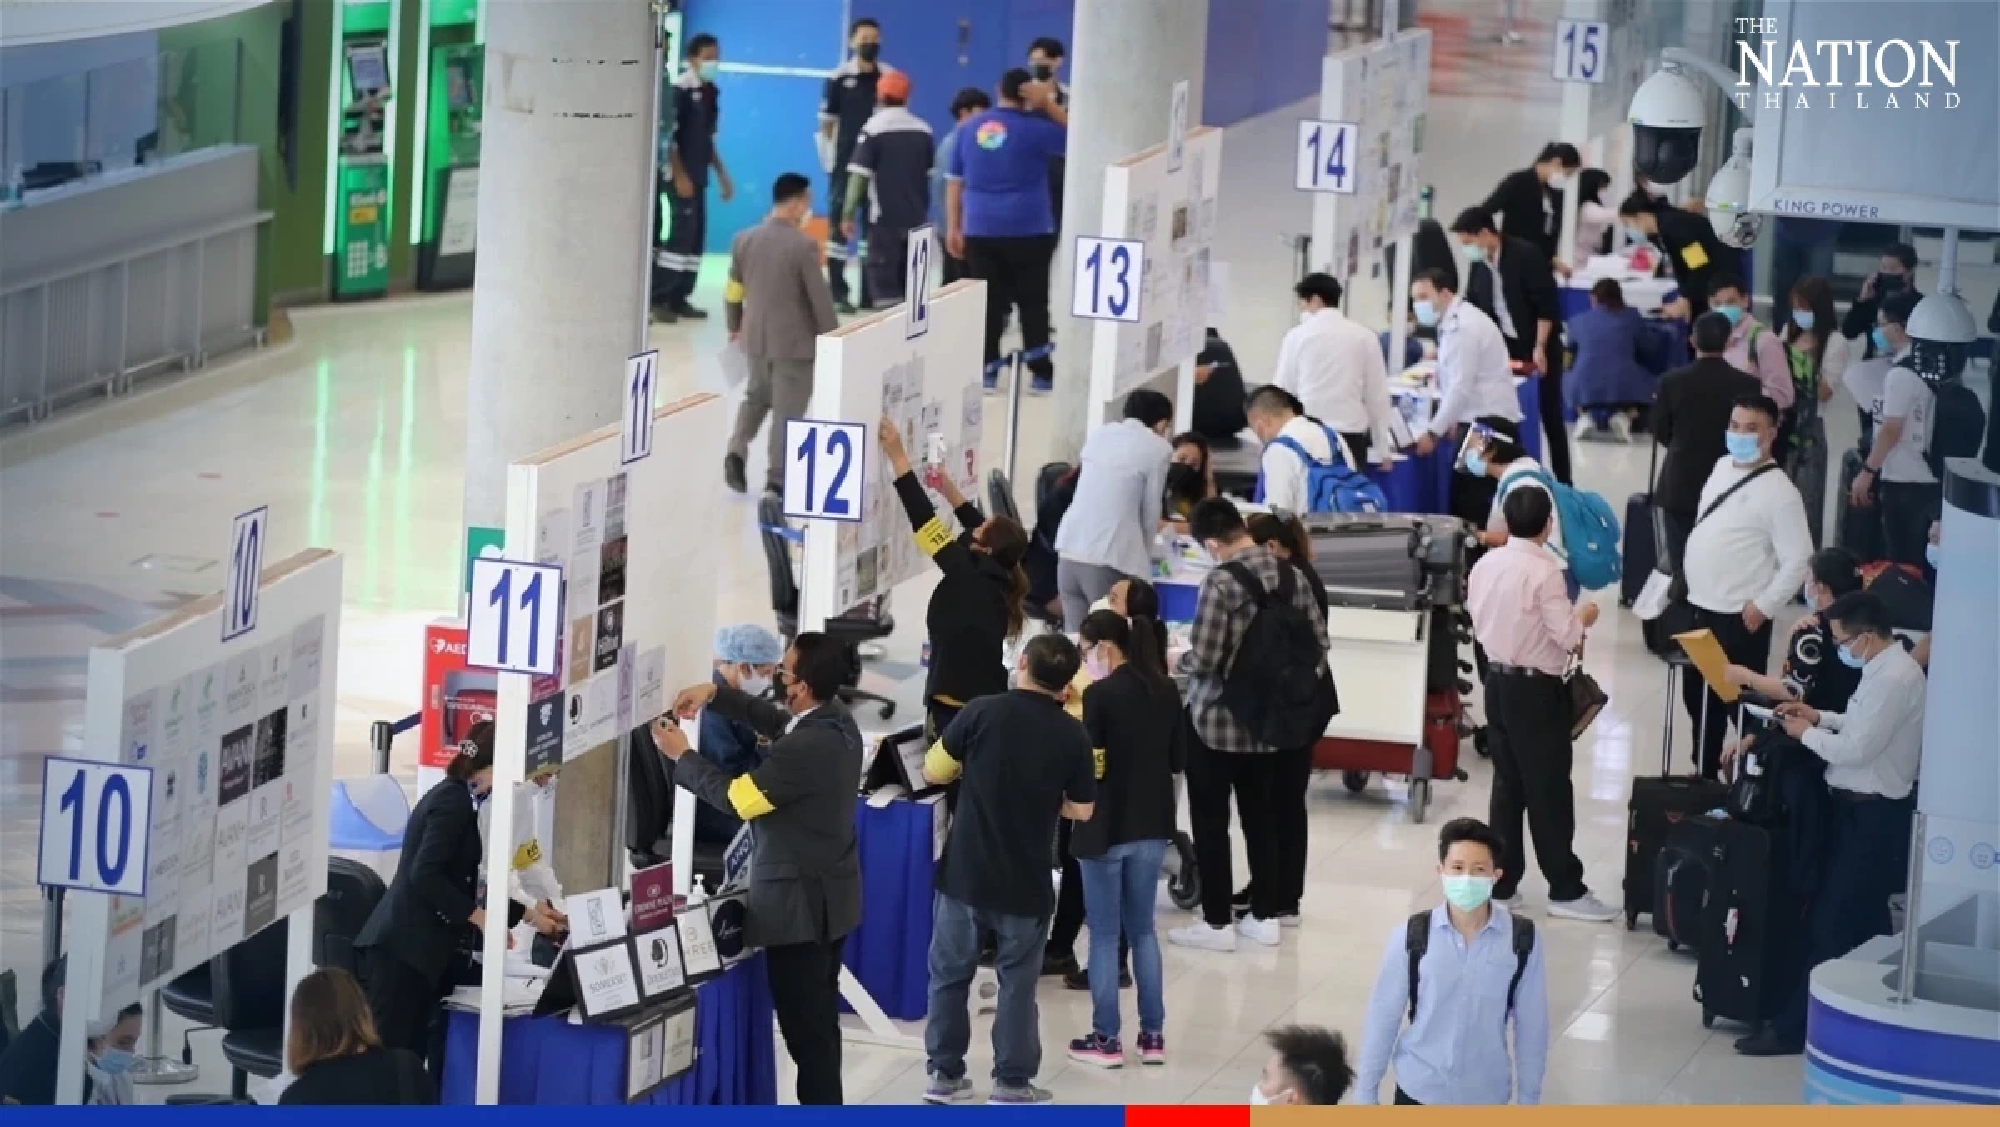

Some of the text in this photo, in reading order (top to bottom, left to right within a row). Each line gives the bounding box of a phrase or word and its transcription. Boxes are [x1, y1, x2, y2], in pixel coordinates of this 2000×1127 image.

[1563, 23, 1598, 79] 15
[1308, 125, 1347, 188] 14
[1774, 198, 1880, 219] KING POWER
[912, 237, 928, 323] 12
[1086, 243, 1130, 317] 13
[632, 358, 652, 455] 11
[796, 427, 854, 516] 12
[232, 518, 258, 631] 10
[489, 569, 543, 668] 11
[59, 769, 133, 887] 10
